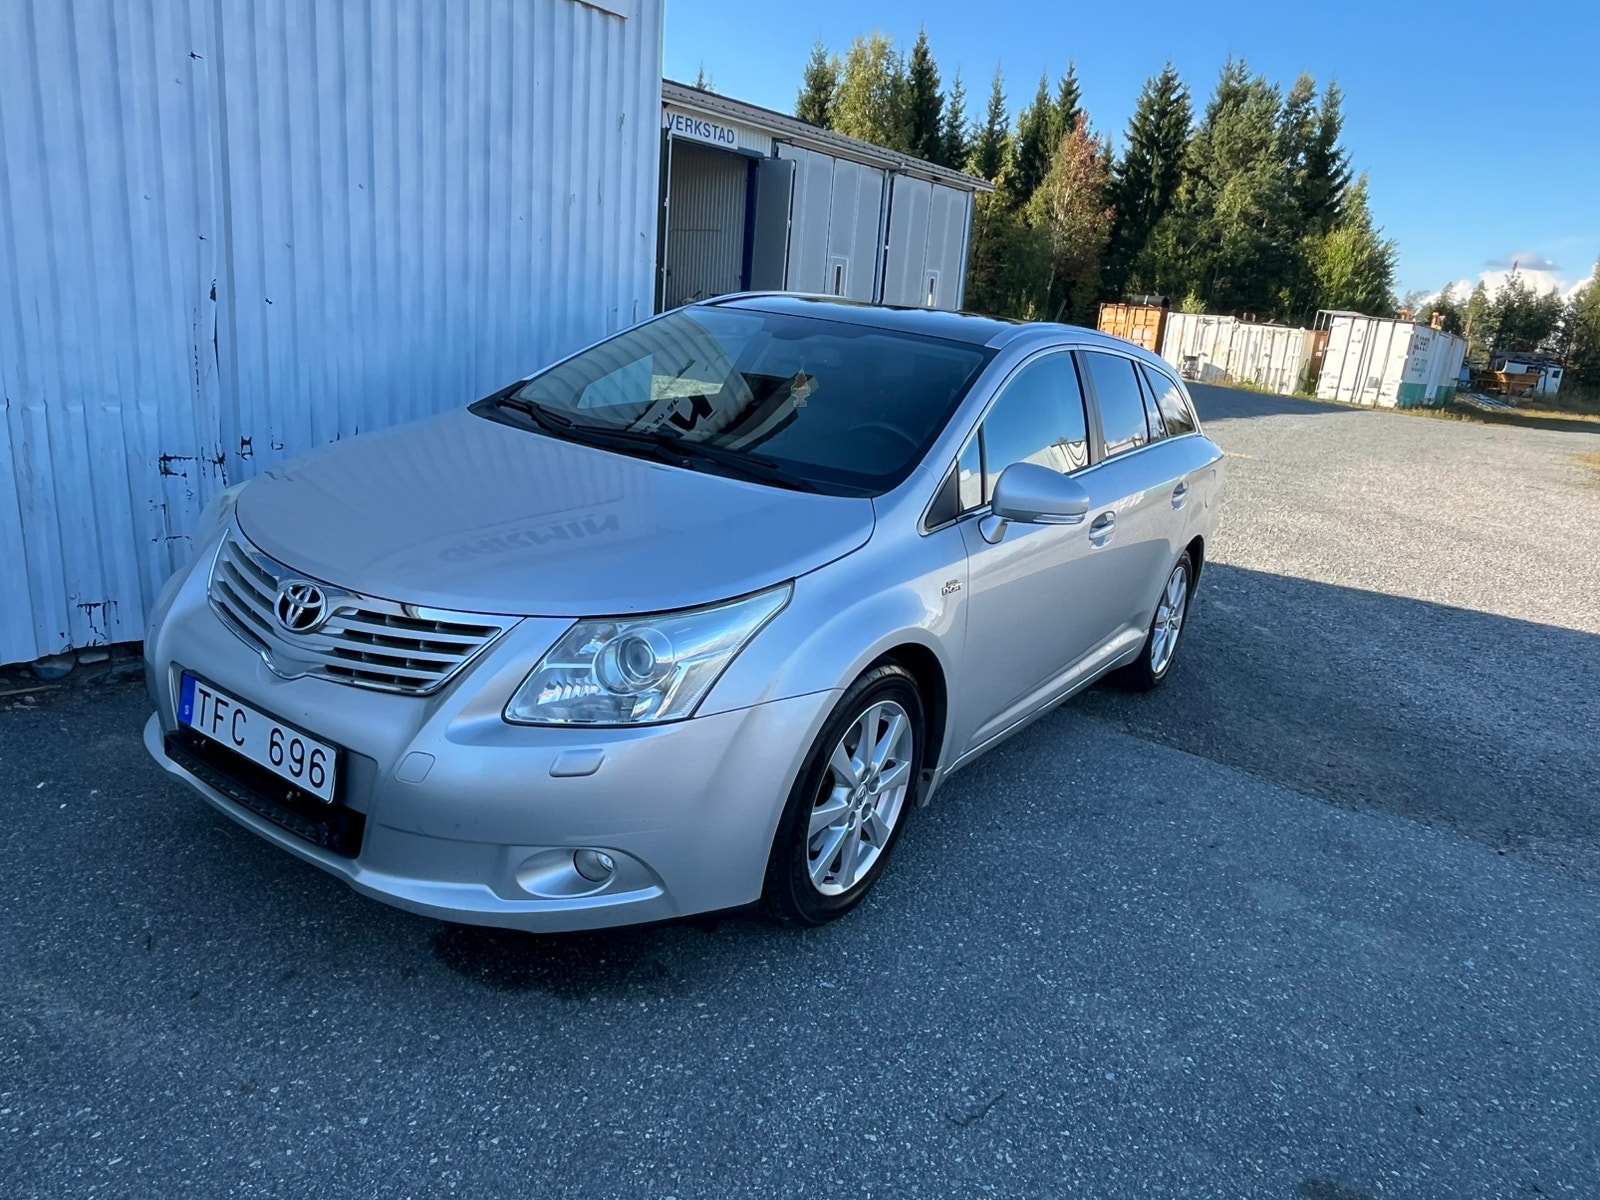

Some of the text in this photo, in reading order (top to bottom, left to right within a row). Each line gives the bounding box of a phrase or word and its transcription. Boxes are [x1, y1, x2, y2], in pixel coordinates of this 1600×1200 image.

[667, 113, 735, 144] VERKSTAD
[184, 705, 190, 715] S
[198, 688, 327, 788] TFC 696
